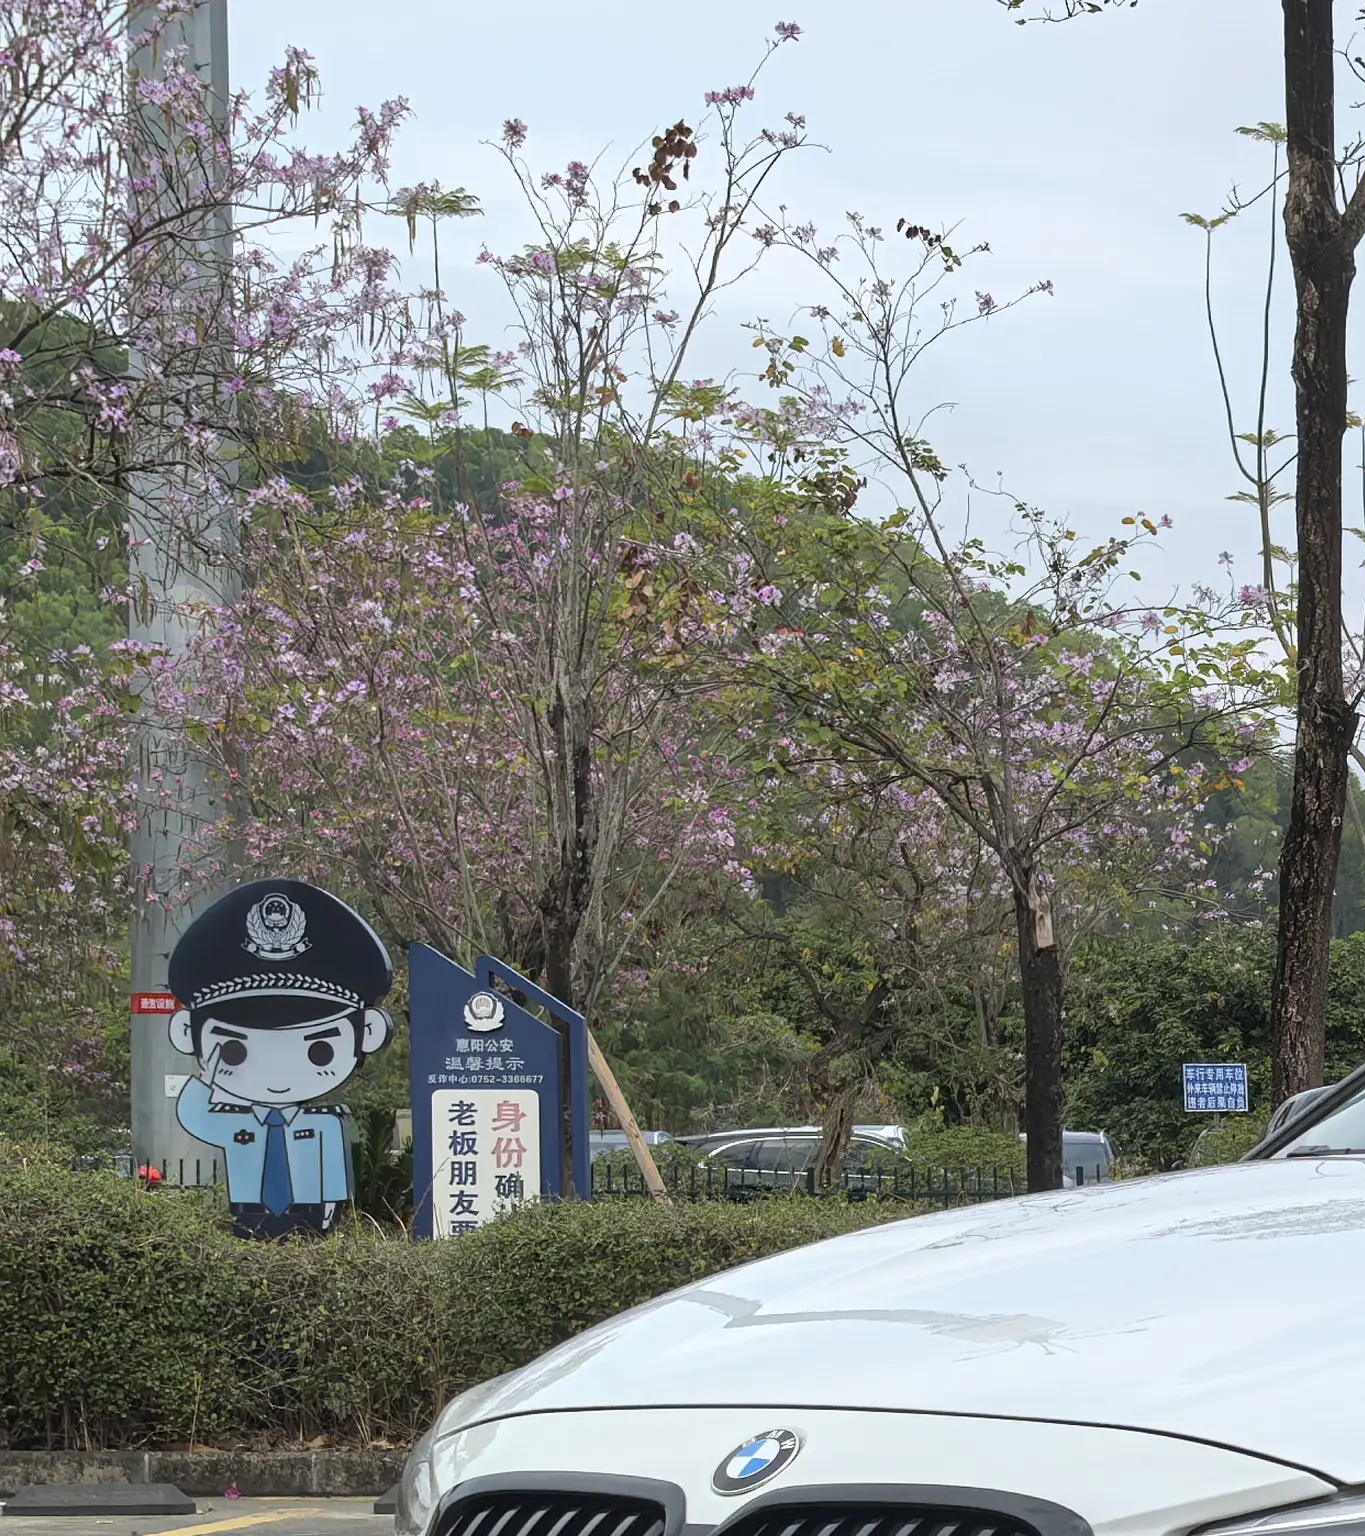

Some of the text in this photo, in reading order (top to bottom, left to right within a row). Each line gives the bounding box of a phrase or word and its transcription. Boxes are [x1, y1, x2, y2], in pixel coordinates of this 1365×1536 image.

[455, 1038, 514, 1053] 惠阳公安
[445, 1056, 525, 1071] 温馨提示
